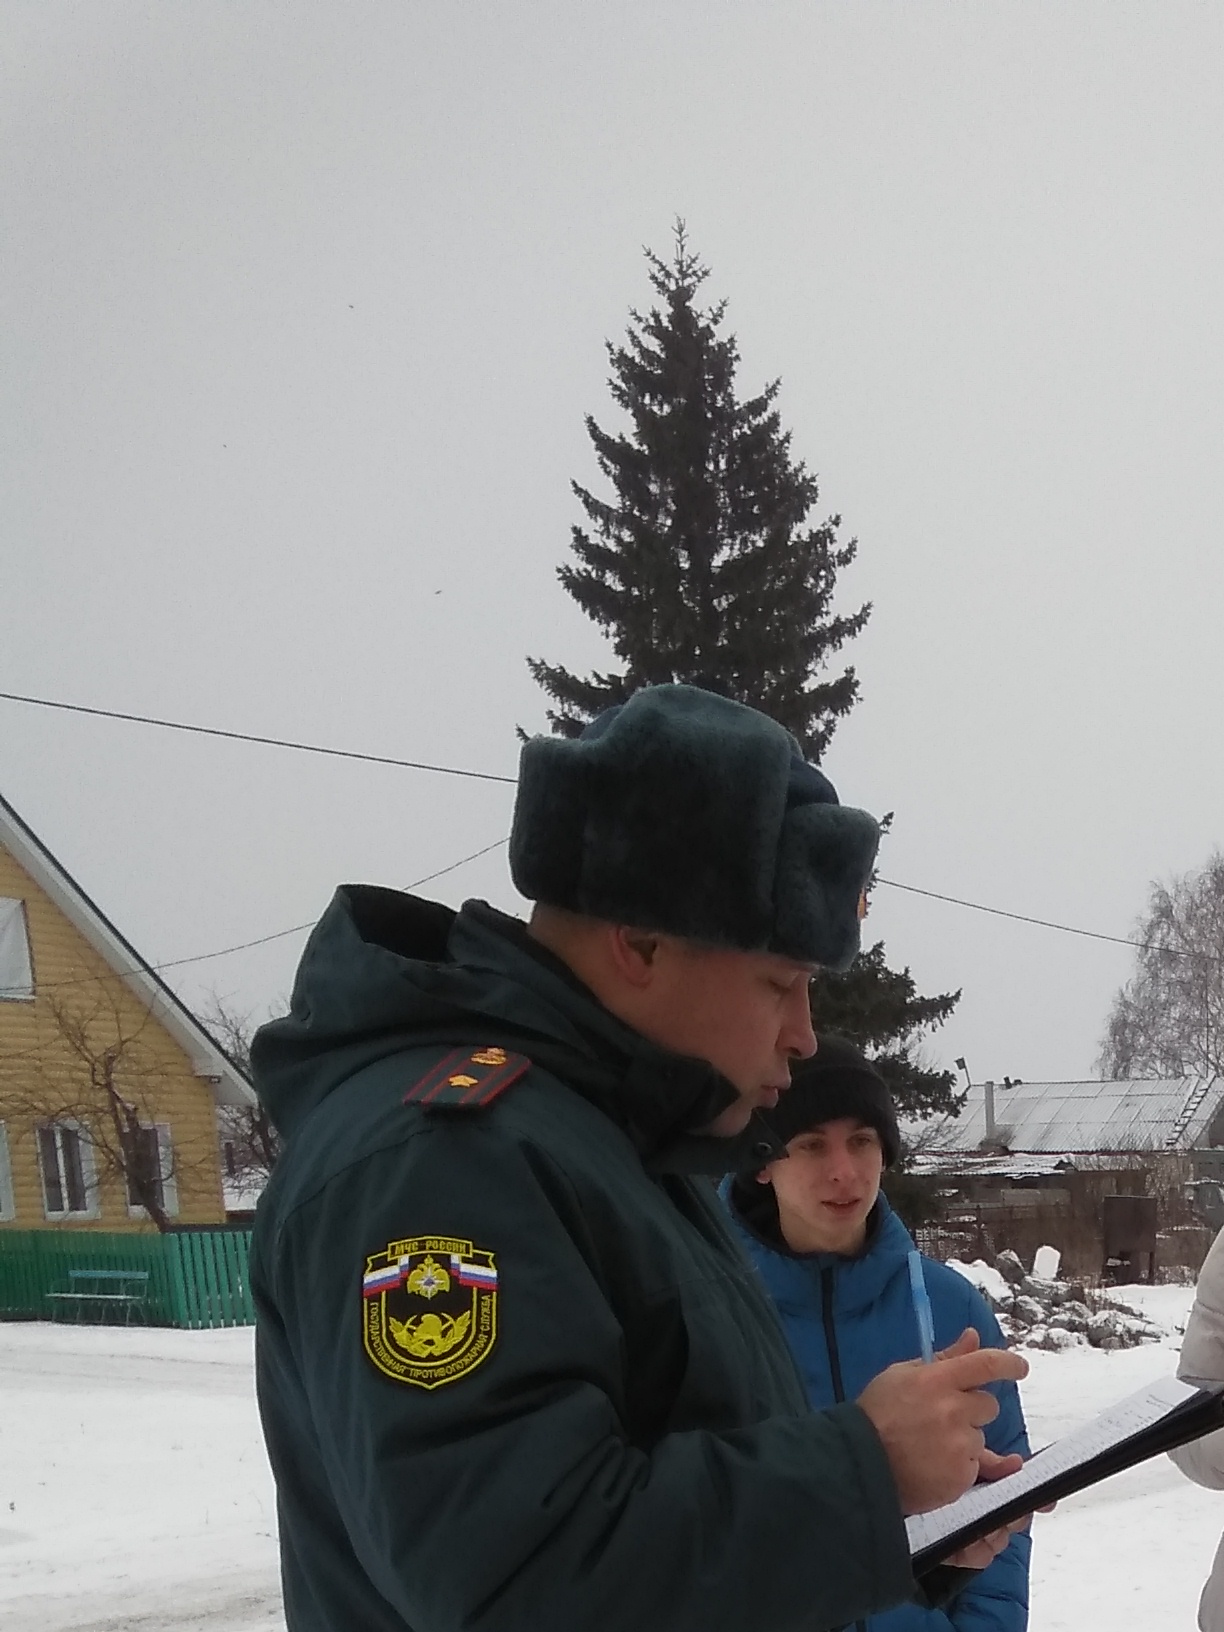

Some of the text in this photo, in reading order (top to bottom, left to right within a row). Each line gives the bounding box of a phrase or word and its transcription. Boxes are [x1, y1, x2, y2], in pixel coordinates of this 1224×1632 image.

[394, 1240, 466, 1255] МЧС РОССИИ
[480, 1294, 492, 1331] СЛУЖБА
